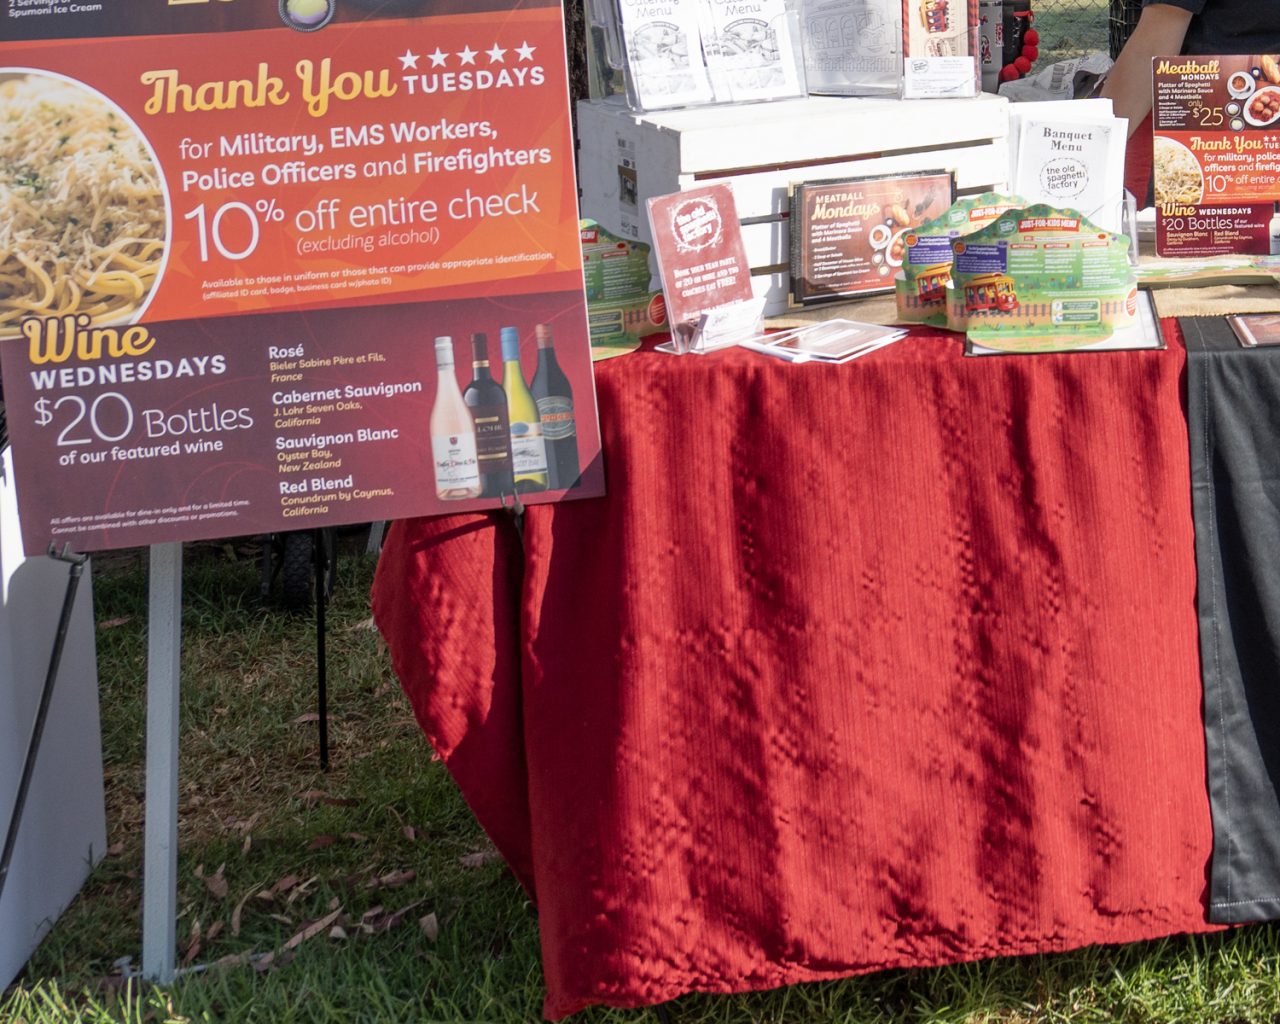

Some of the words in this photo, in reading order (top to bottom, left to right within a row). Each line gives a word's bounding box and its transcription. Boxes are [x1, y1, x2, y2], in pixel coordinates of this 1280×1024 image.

[636, 7, 672, 19] Menu
[725, 4, 762, 16] Menu
[1156, 60, 1220, 75] Meatball
[140, 62, 290, 115] Thank
[296, 58, 398, 117] You
[403, 66, 545, 95] TUESDAYS
[1188, 100, 1203, 108] only
[1193, 108, 1224, 126] $25
[179, 138, 213, 160] for
[220, 133, 324, 156] Military,
[331, 124, 385, 148] EMS
[390, 118, 498, 143] Workers,
[1043, 127, 1093, 142] Banquet
[1051, 140, 1083, 152] Menu
[1190, 136, 1232, 151] Thank
[1232, 136, 1263, 153] You
[1204, 154, 1216, 162] for
[1218, 153, 1254, 163] military,
[1256, 152, 1280, 163] police
[182, 168, 255, 192] Police
[262, 160, 357, 186] Officers
[364, 153, 407, 177] and
[414, 147, 552, 174] Firefighters
[1062, 165, 1075, 173] old
[1204, 163, 1236, 173] officers
[1238, 163, 1255, 171] and
[1206, 174, 1233, 193] 10%
[1236, 174, 1249, 184] off
[1250, 176, 1275, 184] entire
[816, 192, 864, 204] MEATBALL
[811, 202, 880, 221] Mondays
[1162, 202, 1197, 217] Wine
[1199, 208, 1252, 216] WEDNESDAYS
[184, 198, 285, 262] 10%
[296, 198, 341, 232] off
[349, 197, 438, 228] entire
[448, 184, 541, 220] check
[1162, 218, 1185, 231] $20
[1188, 216, 1233, 231] Bottles
[296, 232, 375, 256] (excluding
[378, 226, 440, 247] alcohol)
[22, 314, 156, 365] Wine
[268, 344, 304, 359] Rosé
[31, 355, 227, 390] WEDNESDAYS
[272, 388, 341, 405] Cabernet
[344, 382, 422, 399] Sauvignon
[34, 392, 134, 446] $20
[142, 402, 254, 438] Bottles
[276, 433, 354, 450] Sauvignon
[357, 428, 399, 442] Blanc
[59, 450, 76, 466] of
[80, 448, 106, 464] our
[111, 440, 180, 461] featured
[184, 439, 224, 455] wine
[280, 479, 307, 494] Red
[312, 475, 353, 491] Blend
